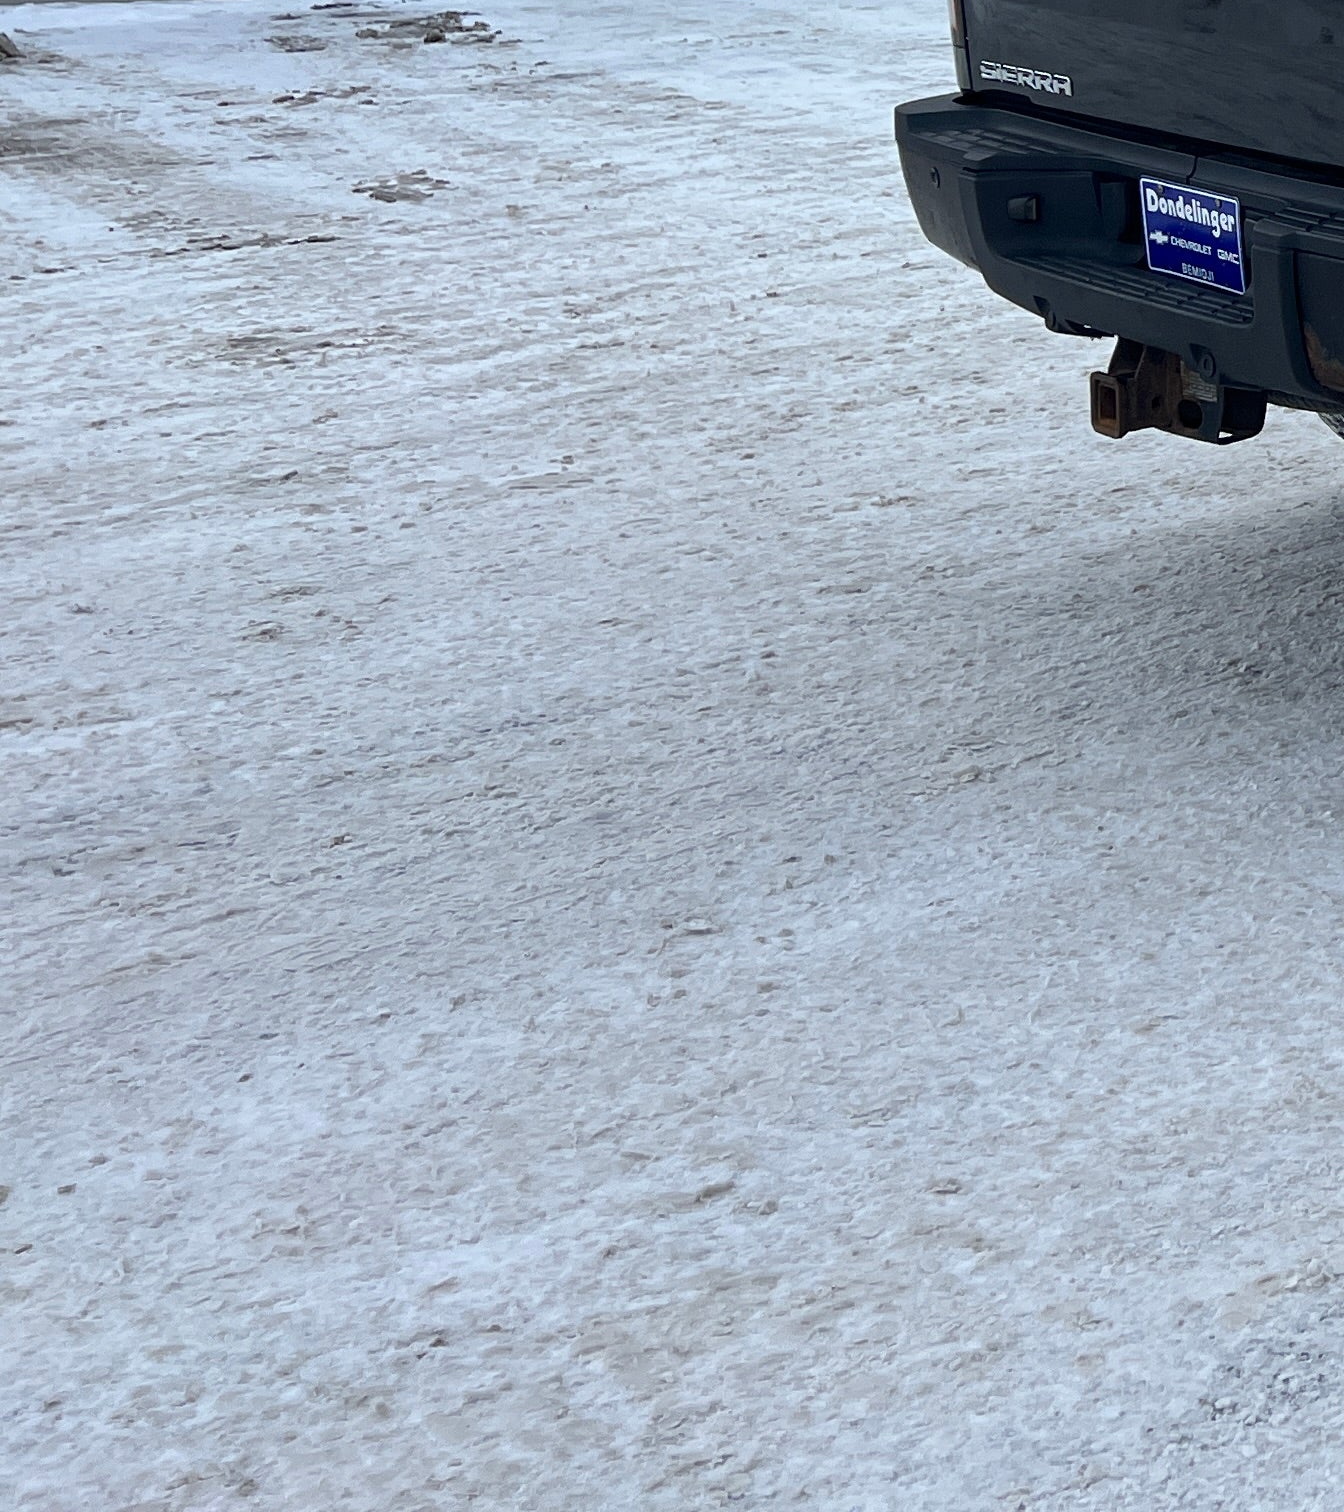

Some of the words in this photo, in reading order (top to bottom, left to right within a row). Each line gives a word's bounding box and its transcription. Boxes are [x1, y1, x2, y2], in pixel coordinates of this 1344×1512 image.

[980, 60, 1072, 96] SIERRA
[1145, 187, 1235, 238] Dondelinger
[1170, 235, 1212, 256] CHEVROLET
[1217, 248, 1240, 265] GMC
[1181, 262, 1215, 282] BEMIDJI
